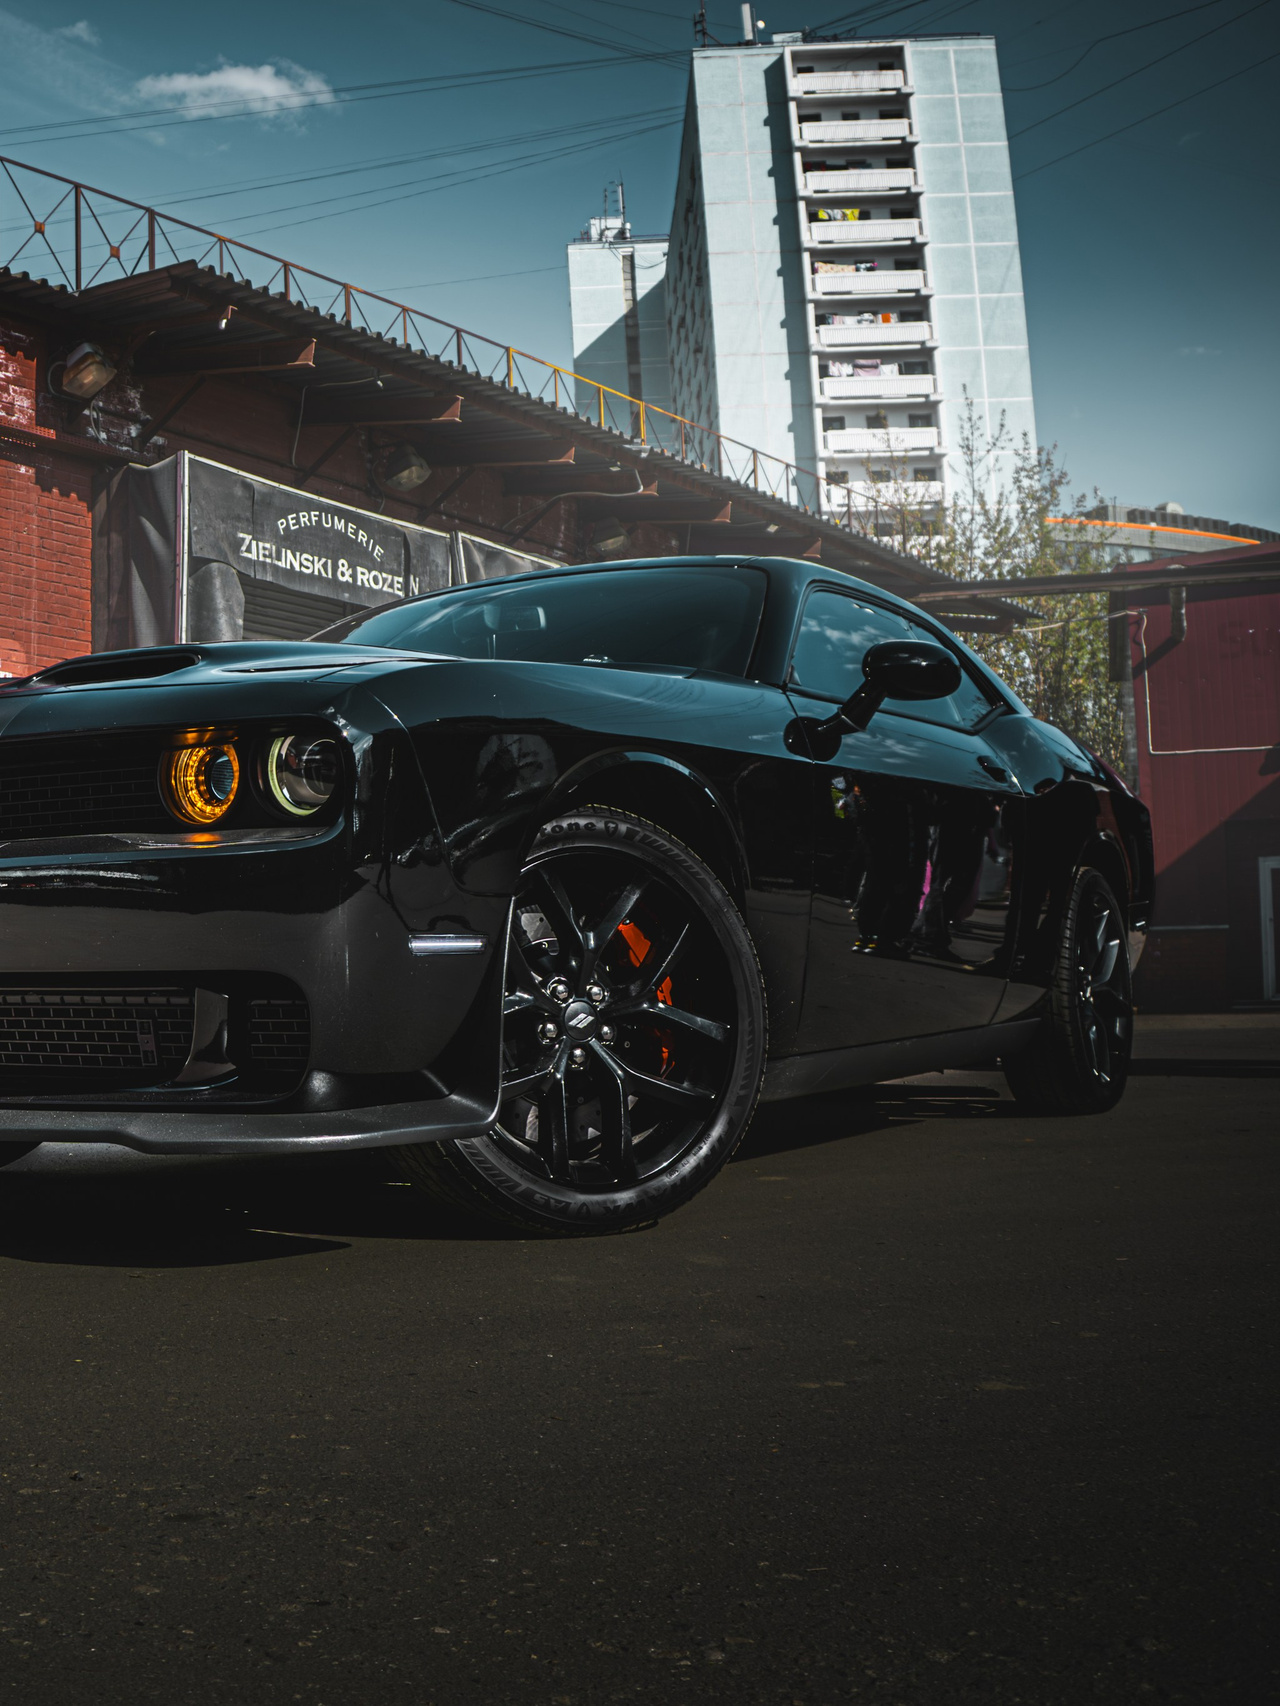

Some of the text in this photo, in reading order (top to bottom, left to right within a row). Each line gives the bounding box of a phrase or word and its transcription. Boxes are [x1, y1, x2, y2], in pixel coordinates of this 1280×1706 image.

[237, 532, 332, 579] ZIELINSKI
[337, 558, 353, 584] &
[277, 511, 384, 562] PERFUMERIE
